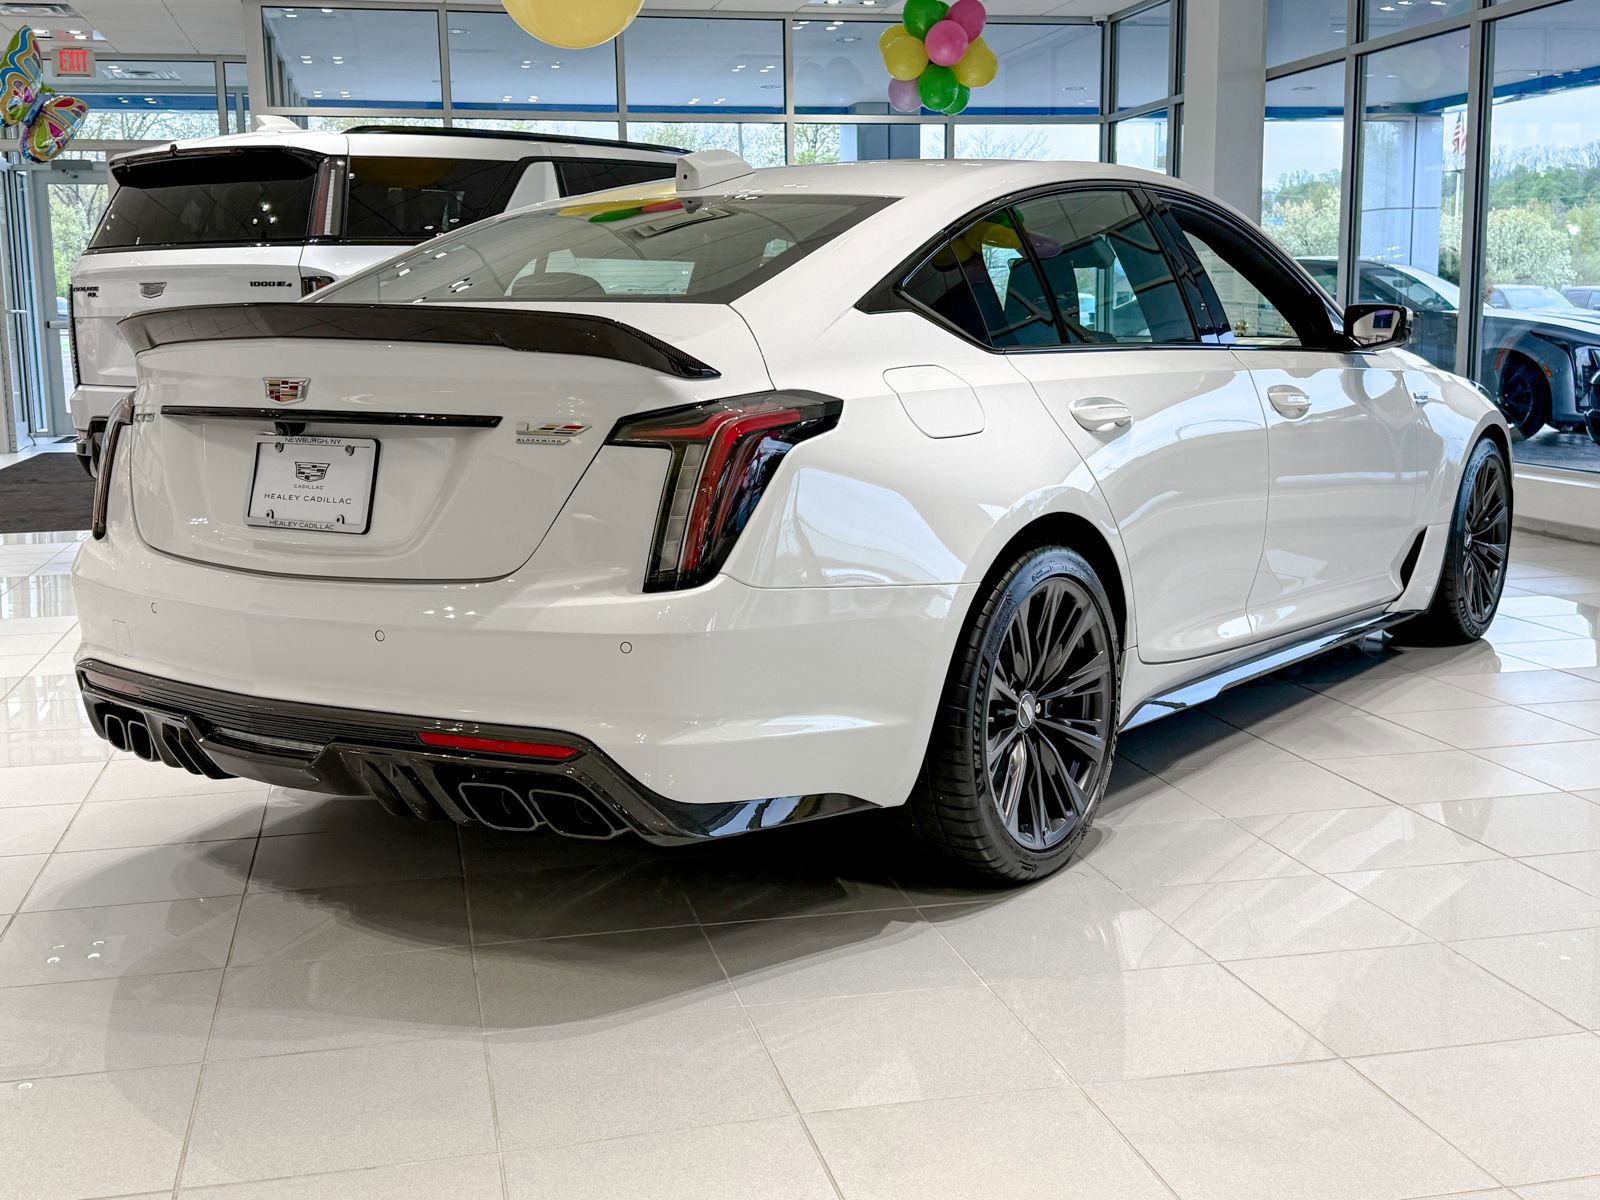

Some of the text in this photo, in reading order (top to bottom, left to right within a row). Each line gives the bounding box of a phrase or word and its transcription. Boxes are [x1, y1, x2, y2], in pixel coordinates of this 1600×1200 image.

[58, 50, 88, 72] EXIT
[264, 493, 352, 505] HEALEY CADILLAC
[269, 520, 335, 531] HEALEY CADILLAC
[974, 663, 988, 769] MICHELIN
